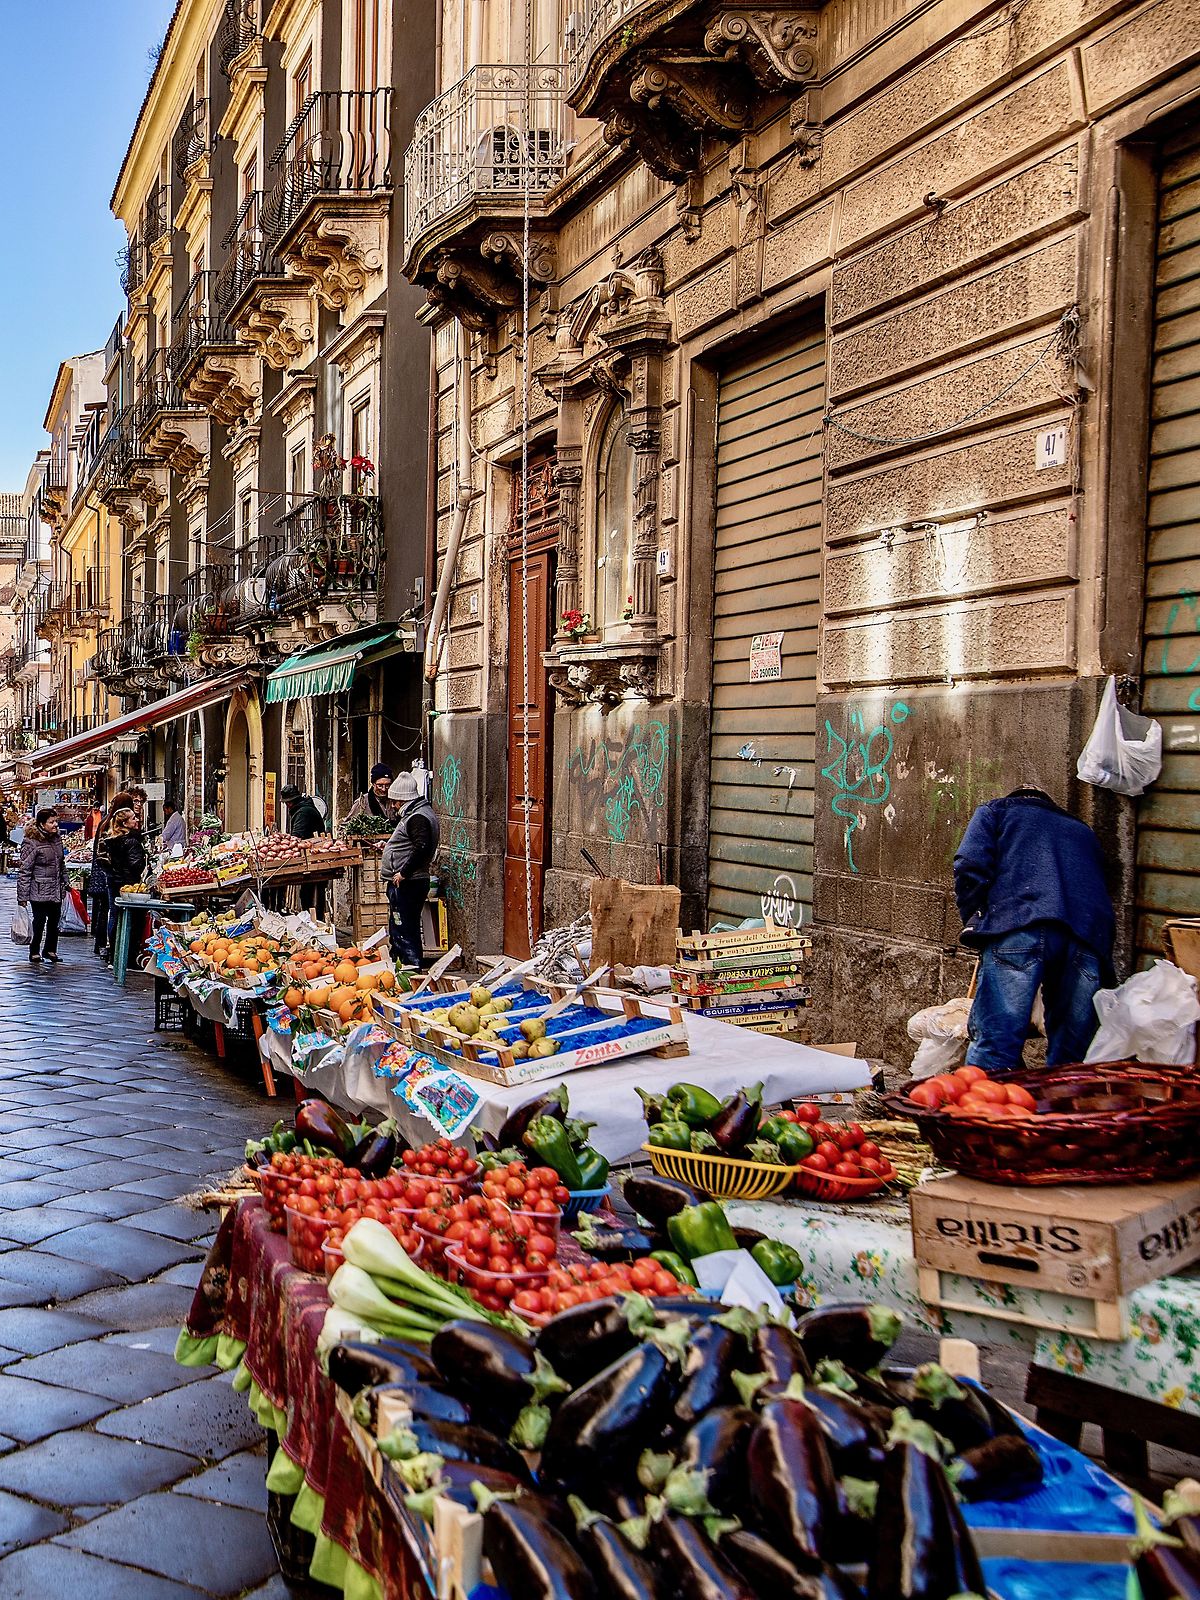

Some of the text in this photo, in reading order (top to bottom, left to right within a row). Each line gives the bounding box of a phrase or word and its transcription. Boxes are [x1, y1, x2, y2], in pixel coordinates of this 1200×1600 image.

[705, 1007, 742, 1016] SQUISITA
[574, 1041, 623, 1066] Zonta
[936, 1217, 1083, 1252] Sicilia
